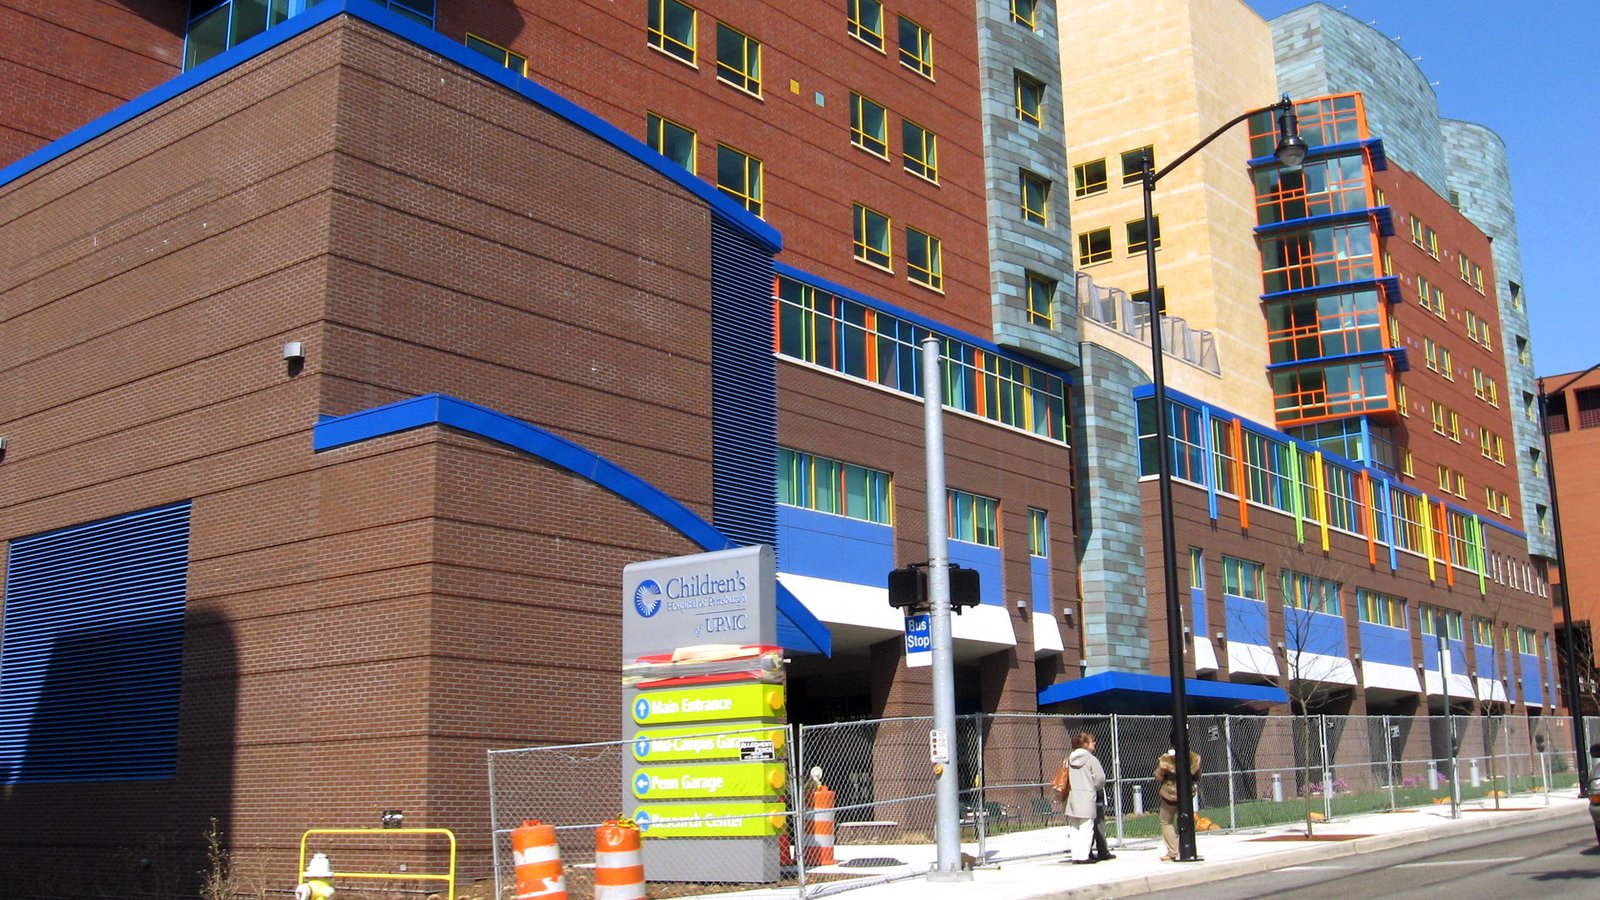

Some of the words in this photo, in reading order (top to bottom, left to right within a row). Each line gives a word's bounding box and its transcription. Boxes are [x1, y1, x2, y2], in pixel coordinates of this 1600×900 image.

[666, 569, 746, 600] Children's
[667, 600, 697, 613] Hospital
[705, 614, 747, 633] UPMC
[908, 620, 927, 632] Bus
[907, 635, 930, 649] Stop
[652, 700, 679, 715] Main
[682, 697, 733, 712] Entrance
[652, 776, 679, 790] Penn
[682, 775, 724, 792] Garage
[652, 813, 702, 828] Research
[705, 813, 743, 828] Center
